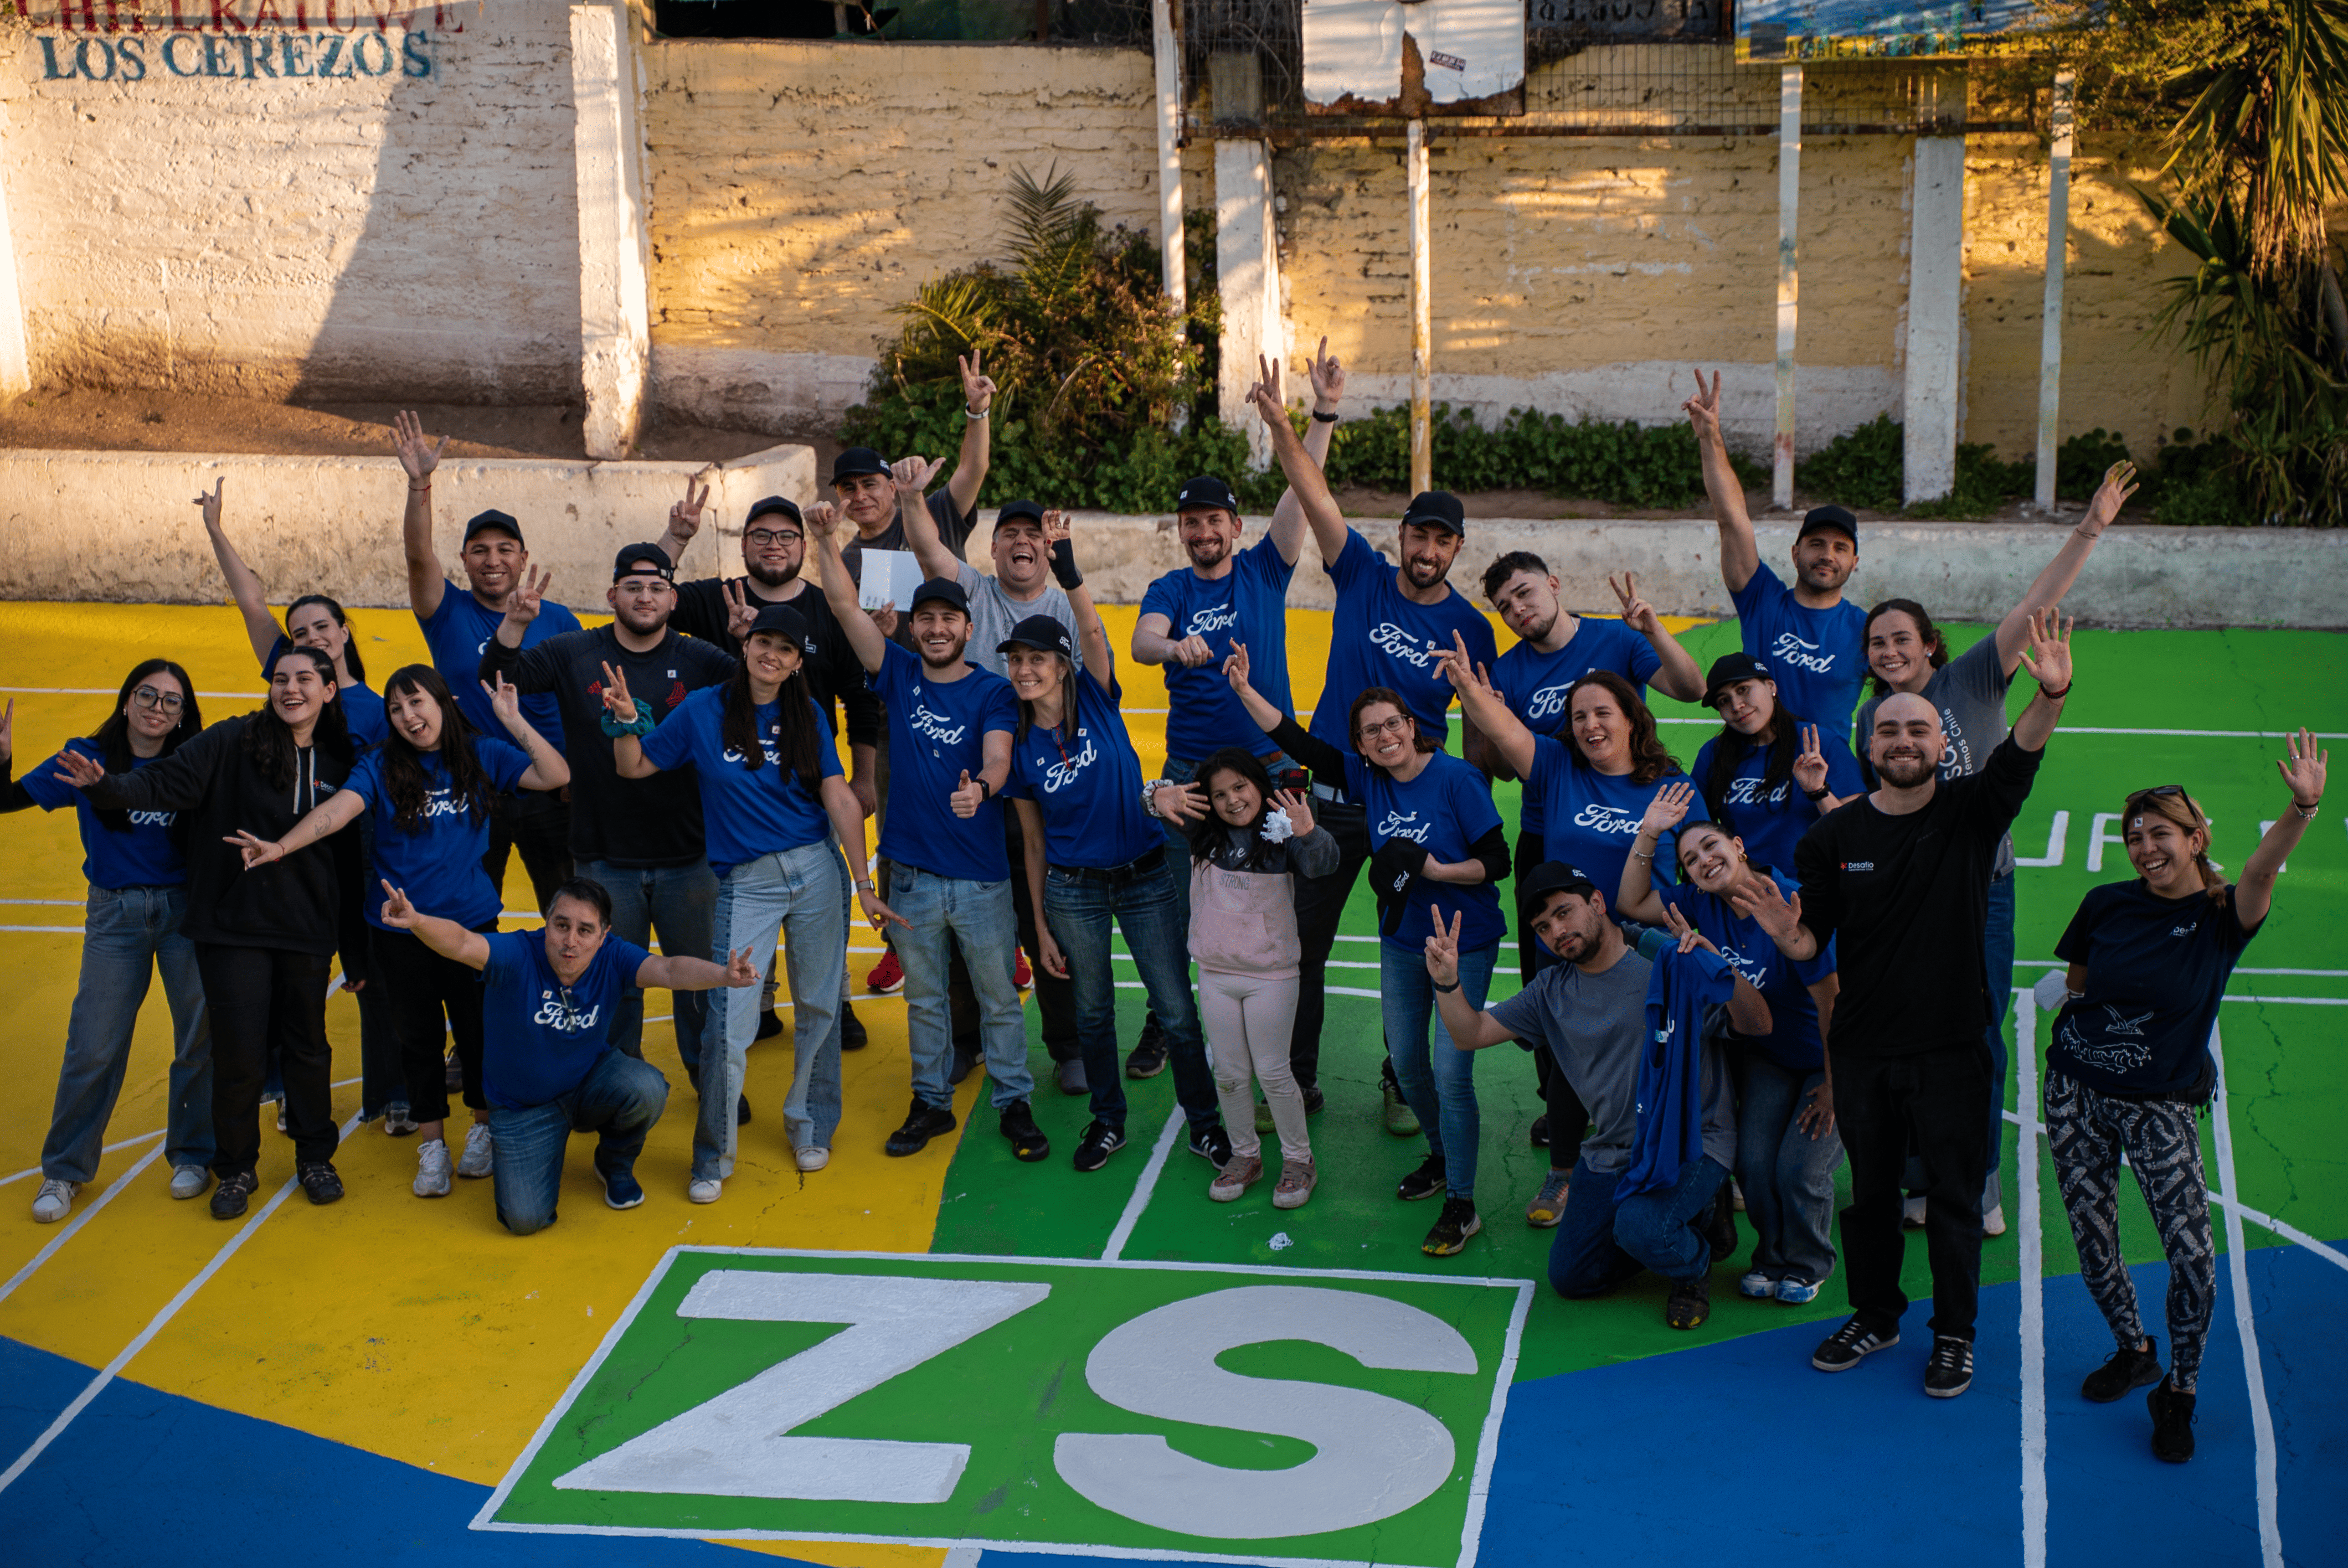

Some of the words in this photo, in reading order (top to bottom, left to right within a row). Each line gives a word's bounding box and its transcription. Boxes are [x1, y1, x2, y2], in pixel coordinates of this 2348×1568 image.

[37, 37, 146, 81] LOS
[162, 30, 432, 79] CEREZOS
[1186, 603, 1238, 636] Ford
[1369, 622, 1430, 667] Ford
[1772, 632, 1836, 673] Ford
[910, 704, 966, 745] Ford
[1944, 708, 1961, 737] Chile
[1044, 739, 1097, 793] Ford
[1574, 803, 1644, 834] Ford
[1219, 873, 1250, 891] STRONG
[1393, 870, 1410, 892] Ford
[534, 1001, 600, 1031] Ford
